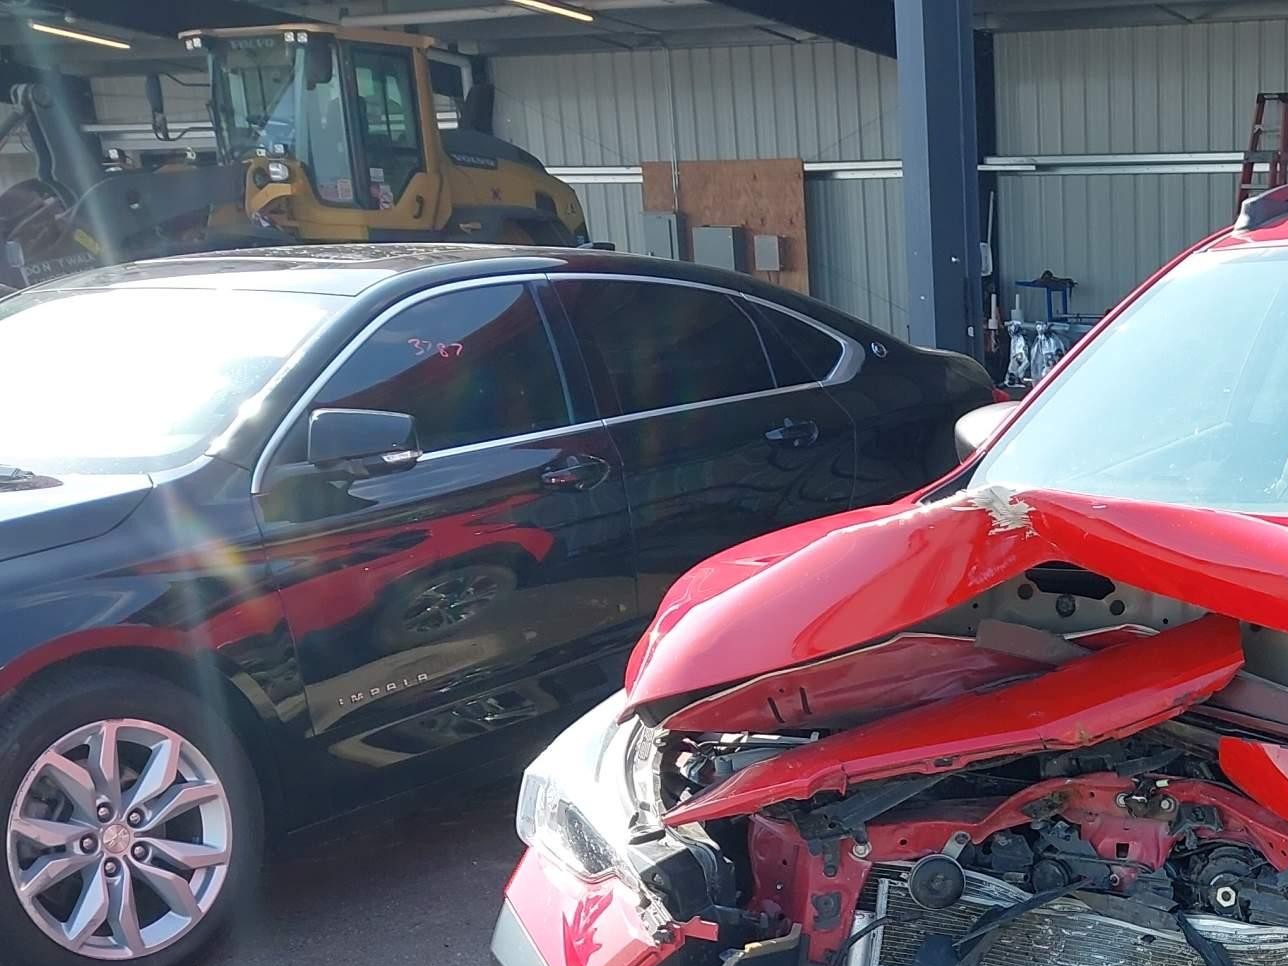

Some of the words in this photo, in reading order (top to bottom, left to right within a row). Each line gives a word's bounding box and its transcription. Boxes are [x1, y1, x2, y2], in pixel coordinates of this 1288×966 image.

[230, 38, 275, 49] VOLVO
[24, 258, 64, 277] DONT
[407, 338, 464, 358] 3787
[338, 672, 429, 706] IMPALA
